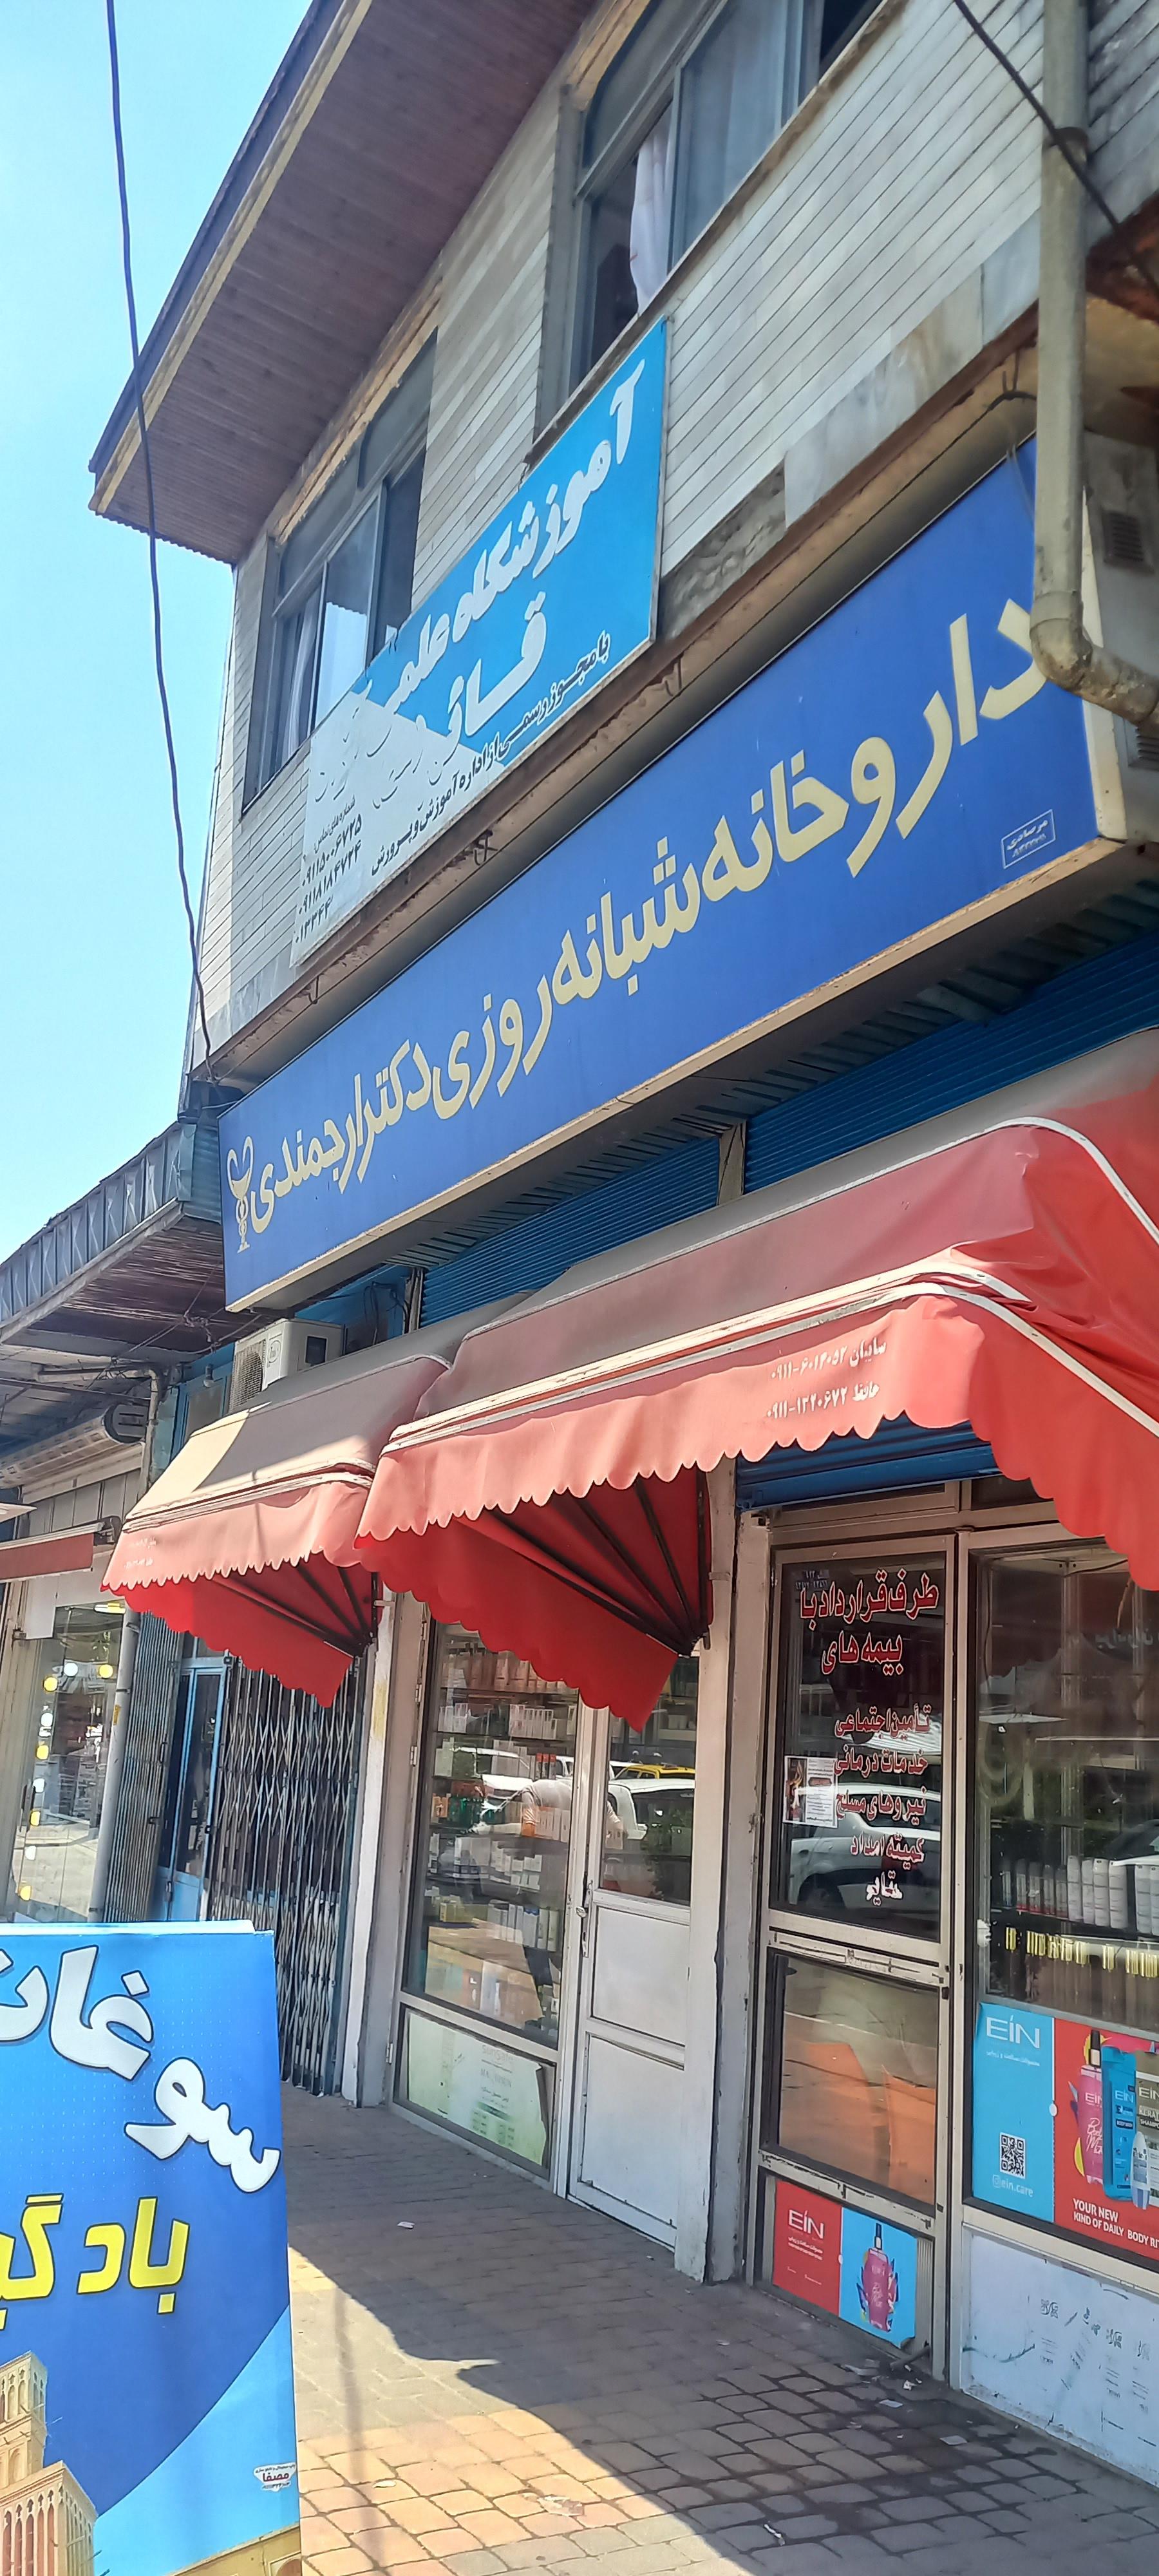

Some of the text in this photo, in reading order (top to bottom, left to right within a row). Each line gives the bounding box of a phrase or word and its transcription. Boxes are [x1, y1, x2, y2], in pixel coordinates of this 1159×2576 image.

[451, 358, 645, 643] آموزشگاه
[596, 628, 611, 665] با
[546, 651, 598, 711] مجوز
[497, 695, 549, 760] رسمی
[458, 746, 487, 791] اداره
[485, 731, 501, 772] از
[419, 770, 459, 831] آموزش
[371, 822, 413, 876] پرورش
[412, 819, 420, 839] و
[250, 598, 1047, 1234] داروخانه شبانه روزی دکتر ارجمندی
[800, 1587, 818, 1631] با
[888, 1567, 939, 1621] طرف
[821, 1630, 904, 1676] بیمه های
[834, 1703, 932, 1741] تأمین اجتماعی
[833, 1743, 880, 1780] درمانی
[880, 1748, 928, 1776] خدمات
[835, 1789, 867, 1821] مسلح
[850, 1830, 925, 1871] کمیته امداد
[1073, 2198, 1118, 2223] YOUR NEW
[1073, 2211, 1091, 2226] KIND
[1092, 2218, 1102, 2229] OF
[1103, 2221, 1124, 2236] DAILY
[1127, 2229, 1149, 2246] BODY
